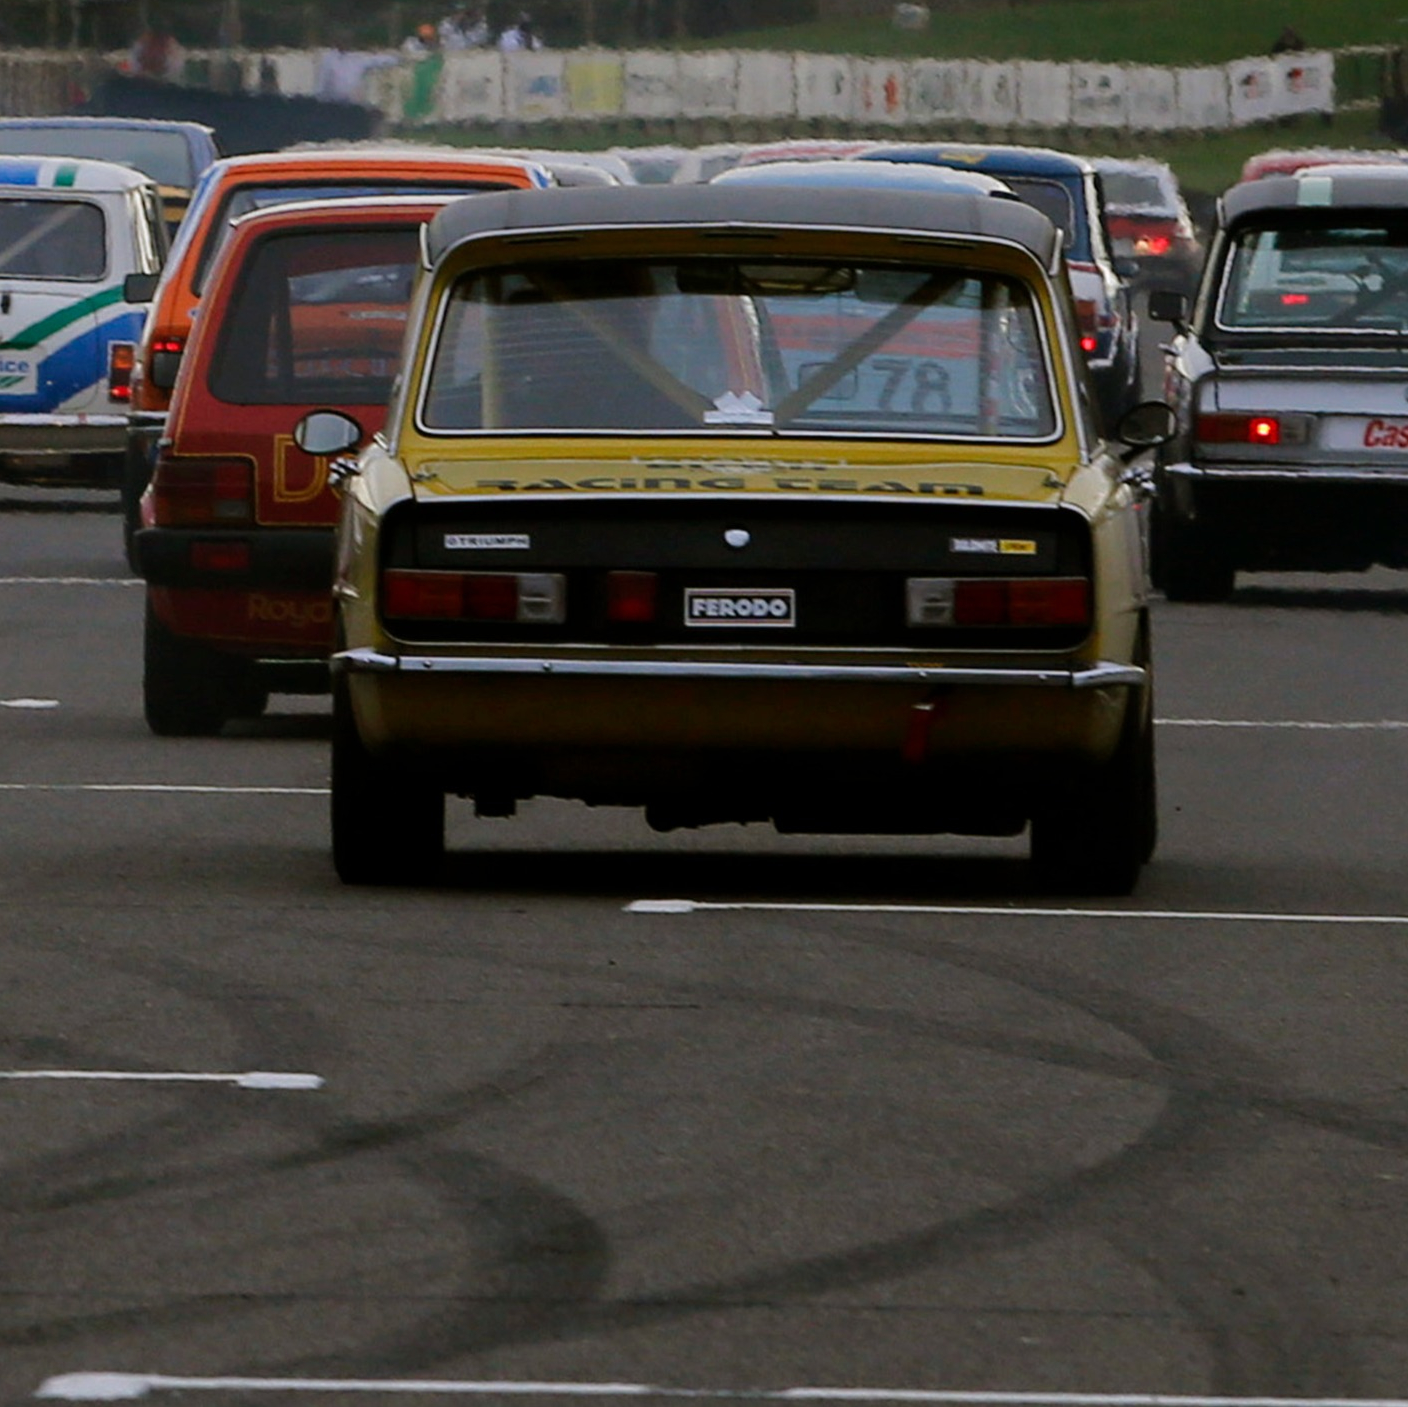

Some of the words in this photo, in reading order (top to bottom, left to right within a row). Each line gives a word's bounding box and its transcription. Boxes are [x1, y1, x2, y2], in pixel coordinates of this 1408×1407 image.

[871, 358, 952, 412] 78
[458, 536, 530, 546] TRIUMPH
[691, 597, 788, 617] FERODO
